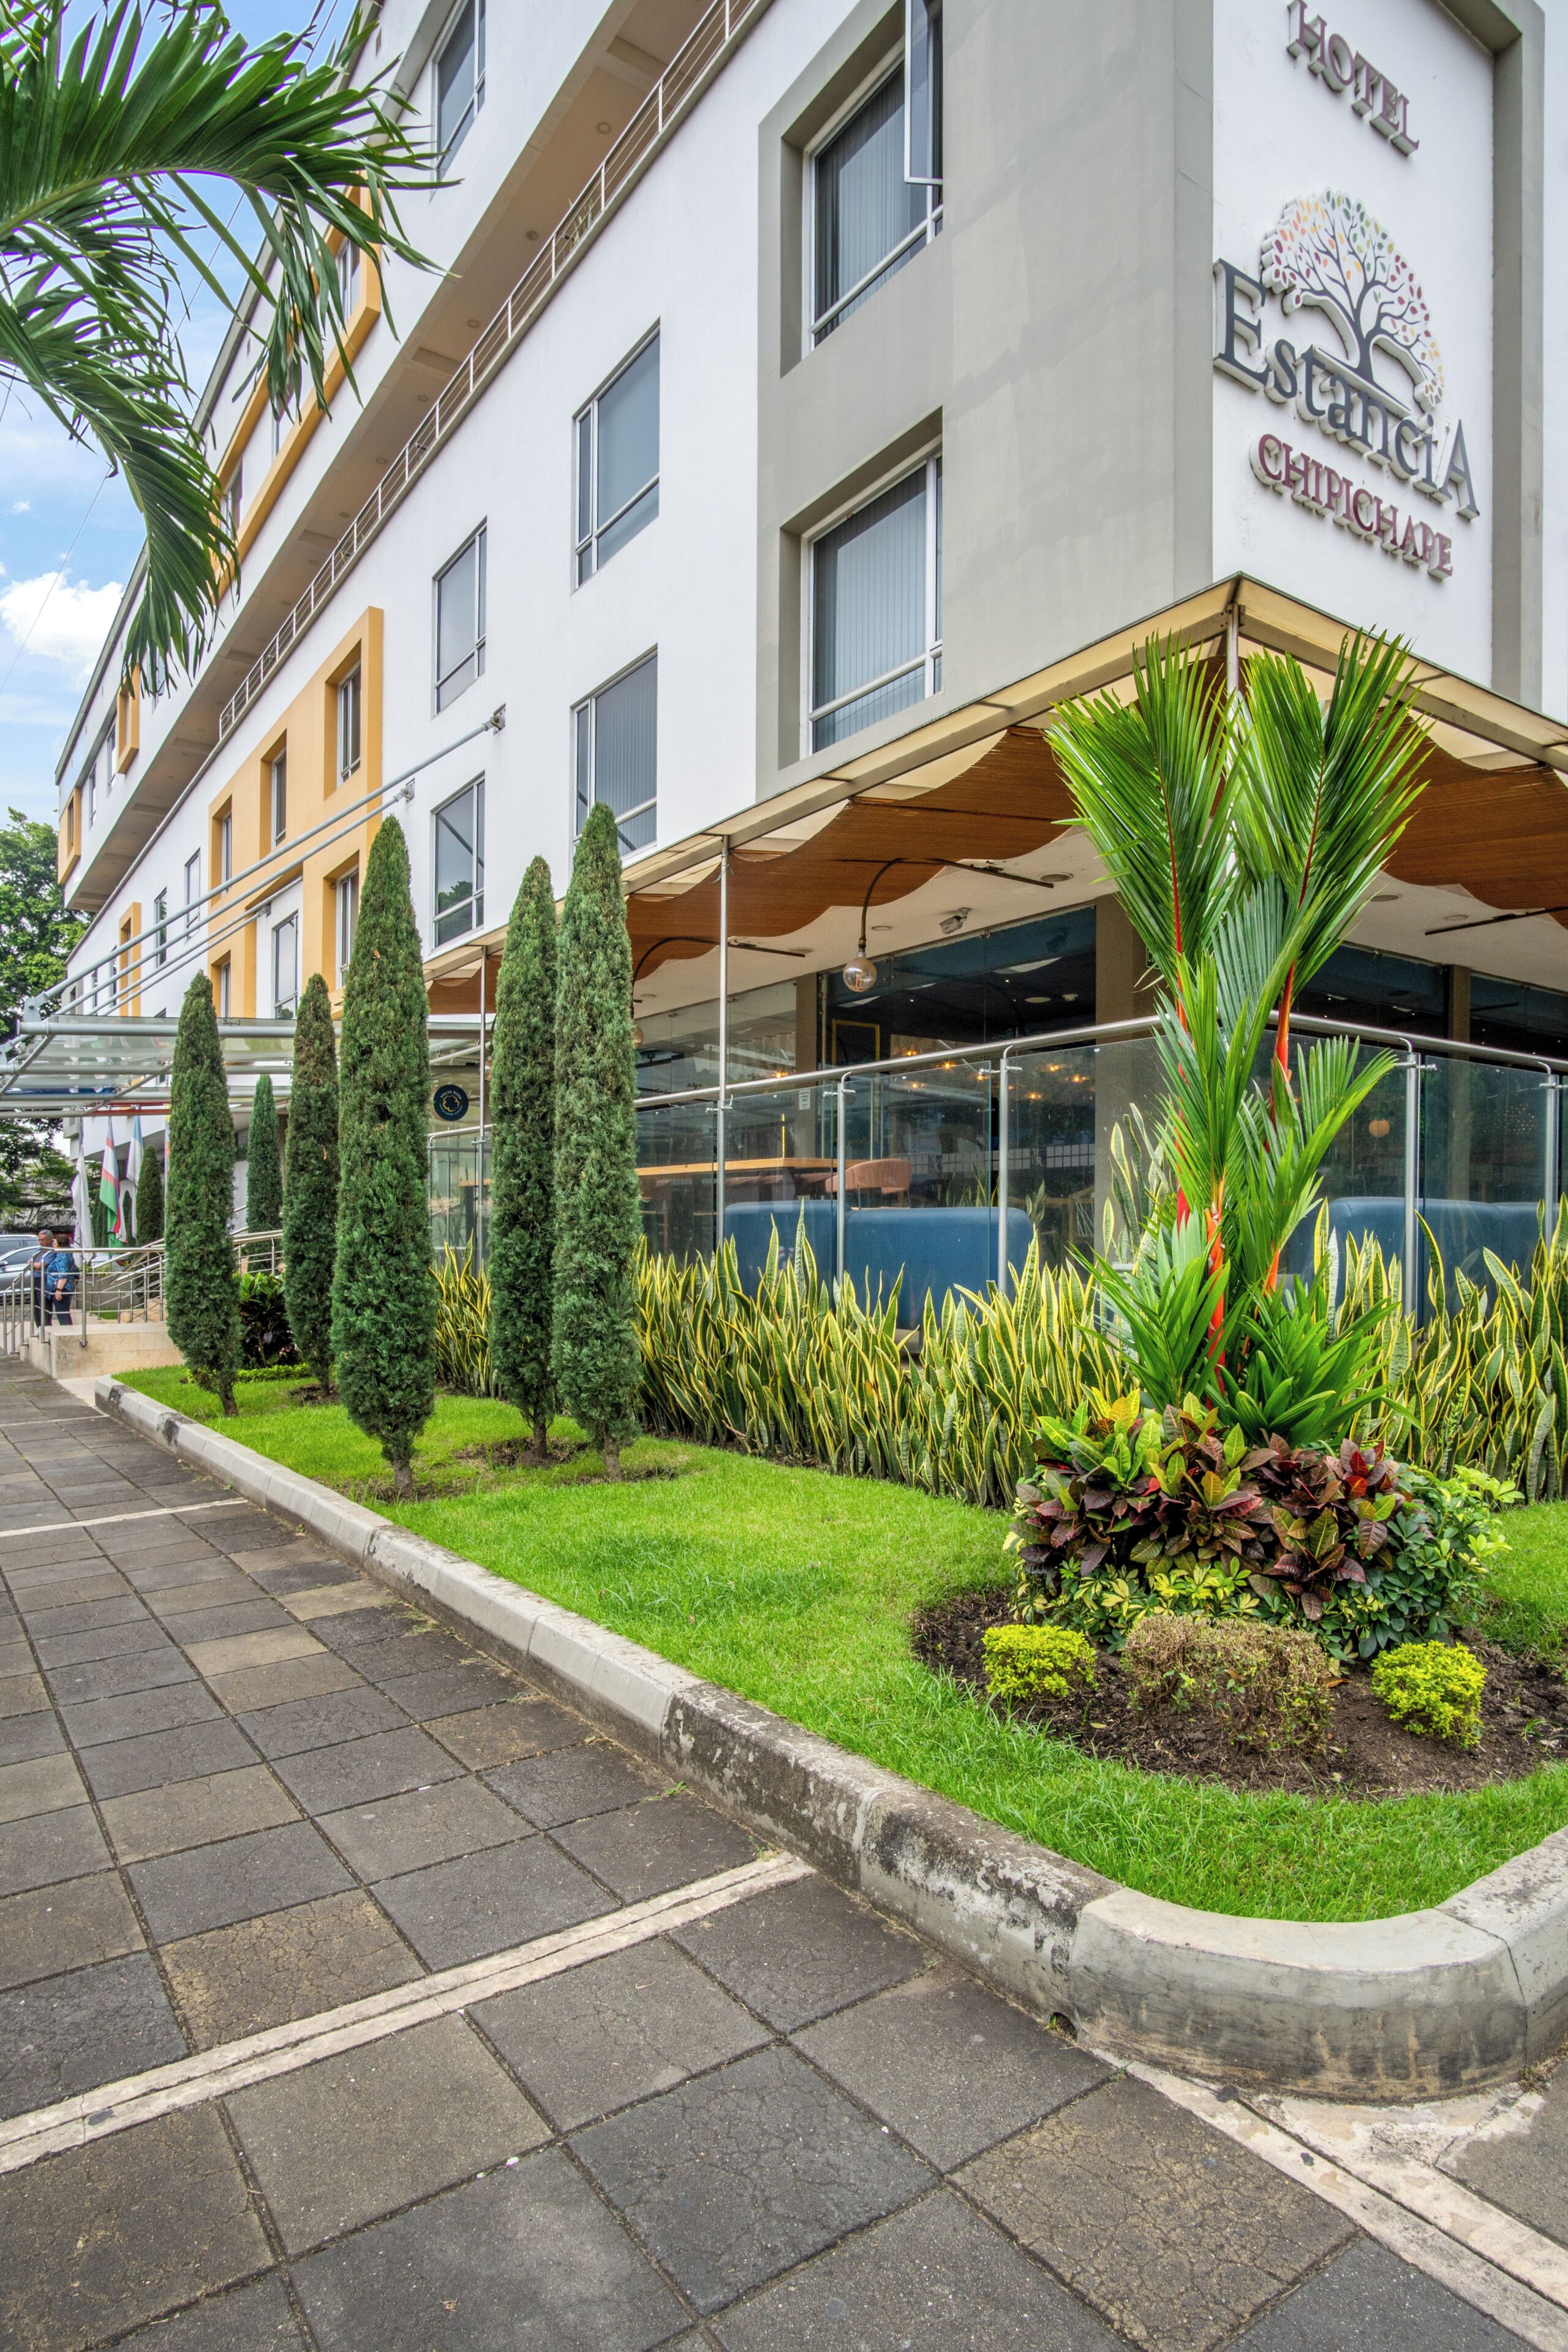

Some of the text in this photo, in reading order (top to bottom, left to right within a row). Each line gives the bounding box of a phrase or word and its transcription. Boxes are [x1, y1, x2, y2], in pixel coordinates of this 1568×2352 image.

[1290, 0, 1419, 151] HOTEL
[1256, 434, 1453, 576] CHIPICHAPE
[453, 1091, 462, 1100] ROSA
